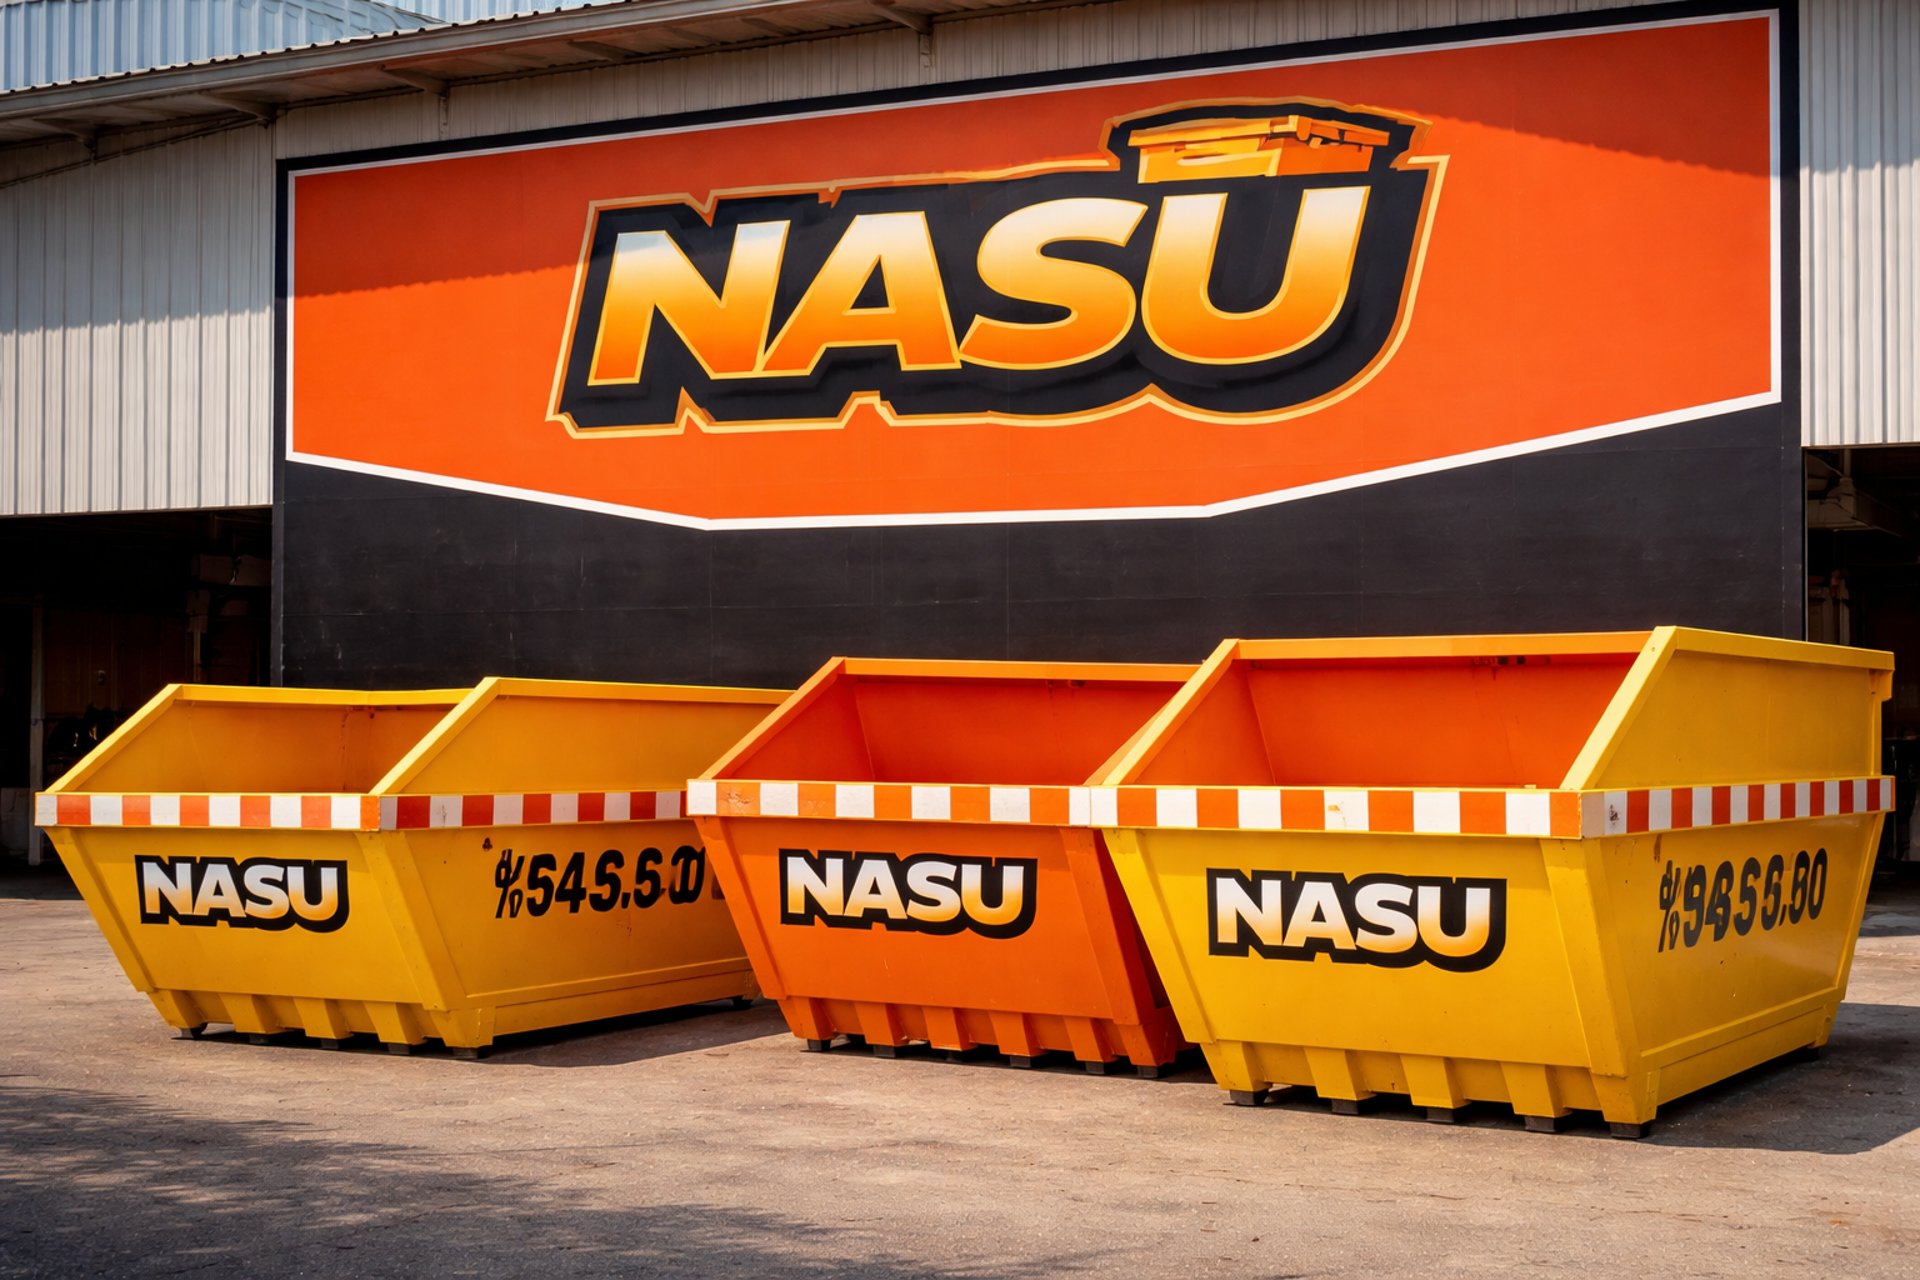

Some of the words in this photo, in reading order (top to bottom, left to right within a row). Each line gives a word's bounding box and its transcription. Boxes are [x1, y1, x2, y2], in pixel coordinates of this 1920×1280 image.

[587, 185, 1371, 386] NASU
[141, 860, 340, 923] NASU
[785, 855, 1026, 927] NASU
[1214, 876, 1493, 959] NASU
